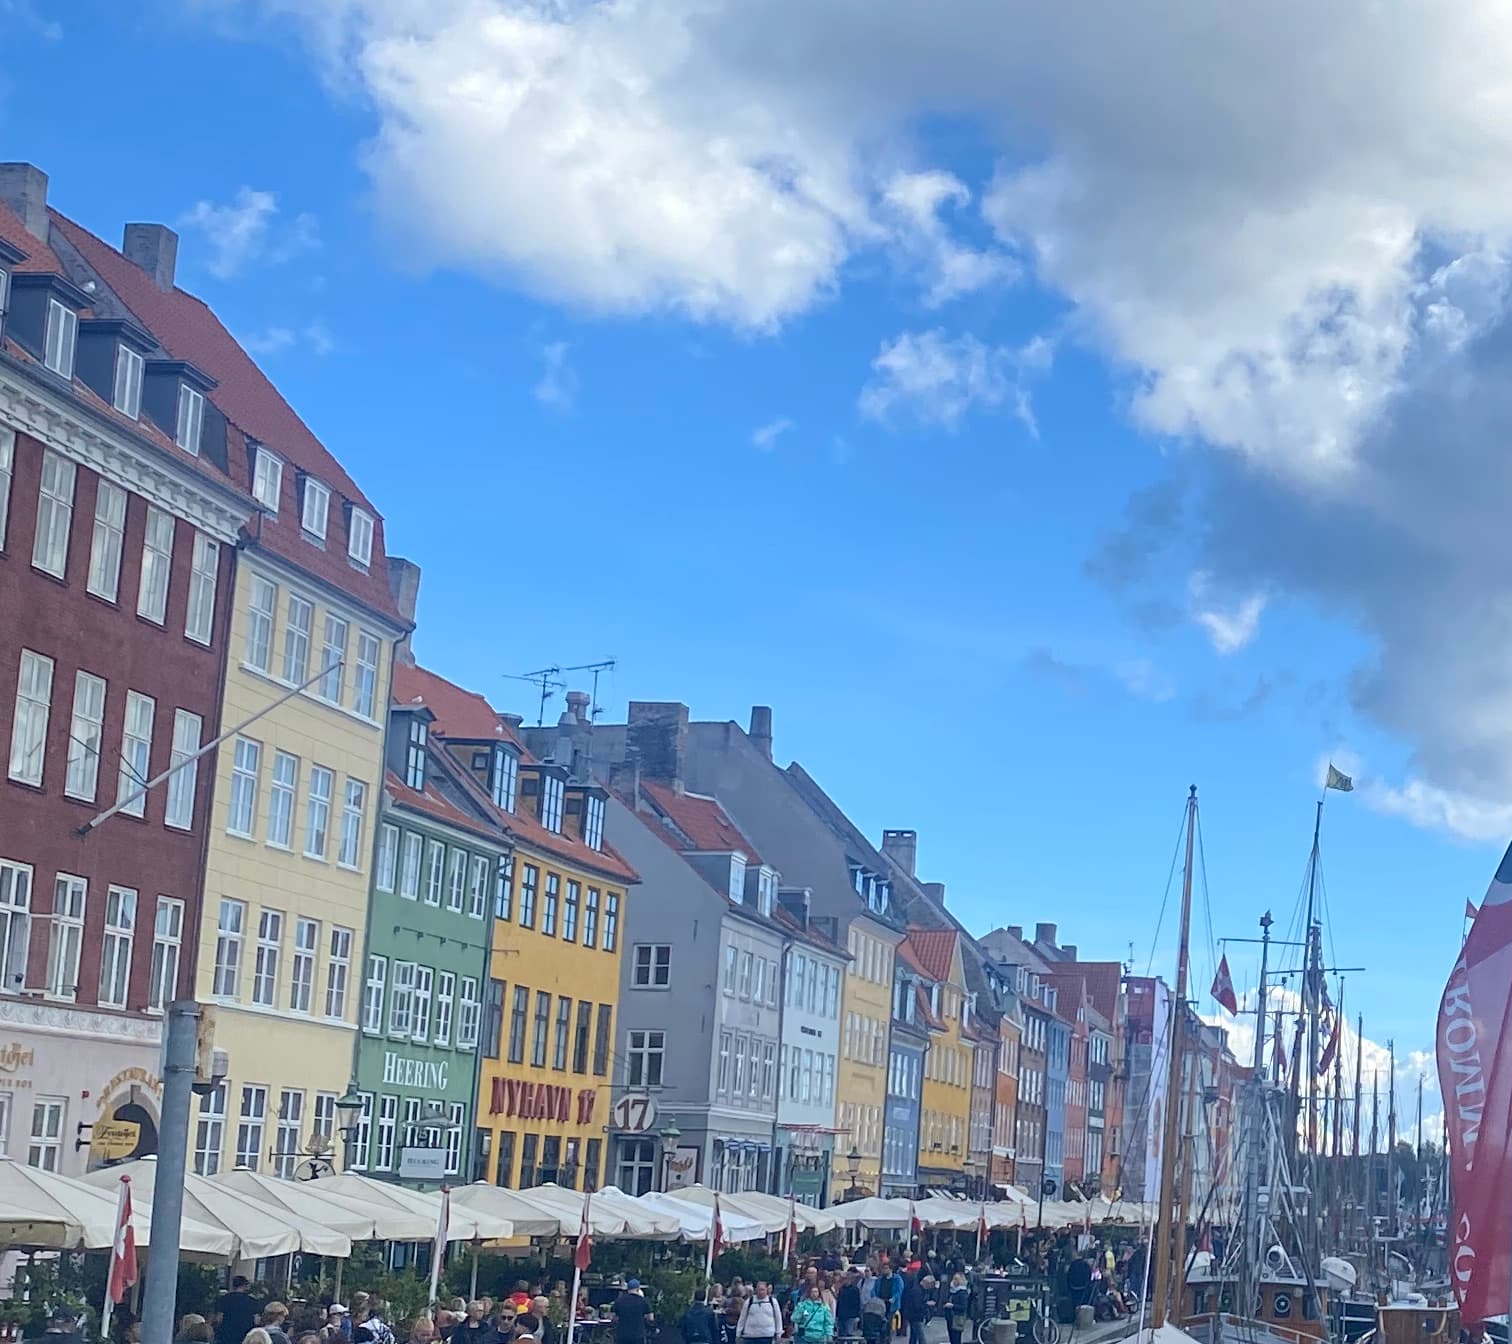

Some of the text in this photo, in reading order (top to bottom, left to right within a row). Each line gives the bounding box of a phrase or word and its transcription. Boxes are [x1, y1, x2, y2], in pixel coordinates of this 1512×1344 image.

[382, 1052, 449, 1090] HEERING
[489, 1077, 572, 1123] NYHAVN
[617, 1100, 648, 1131] 17
